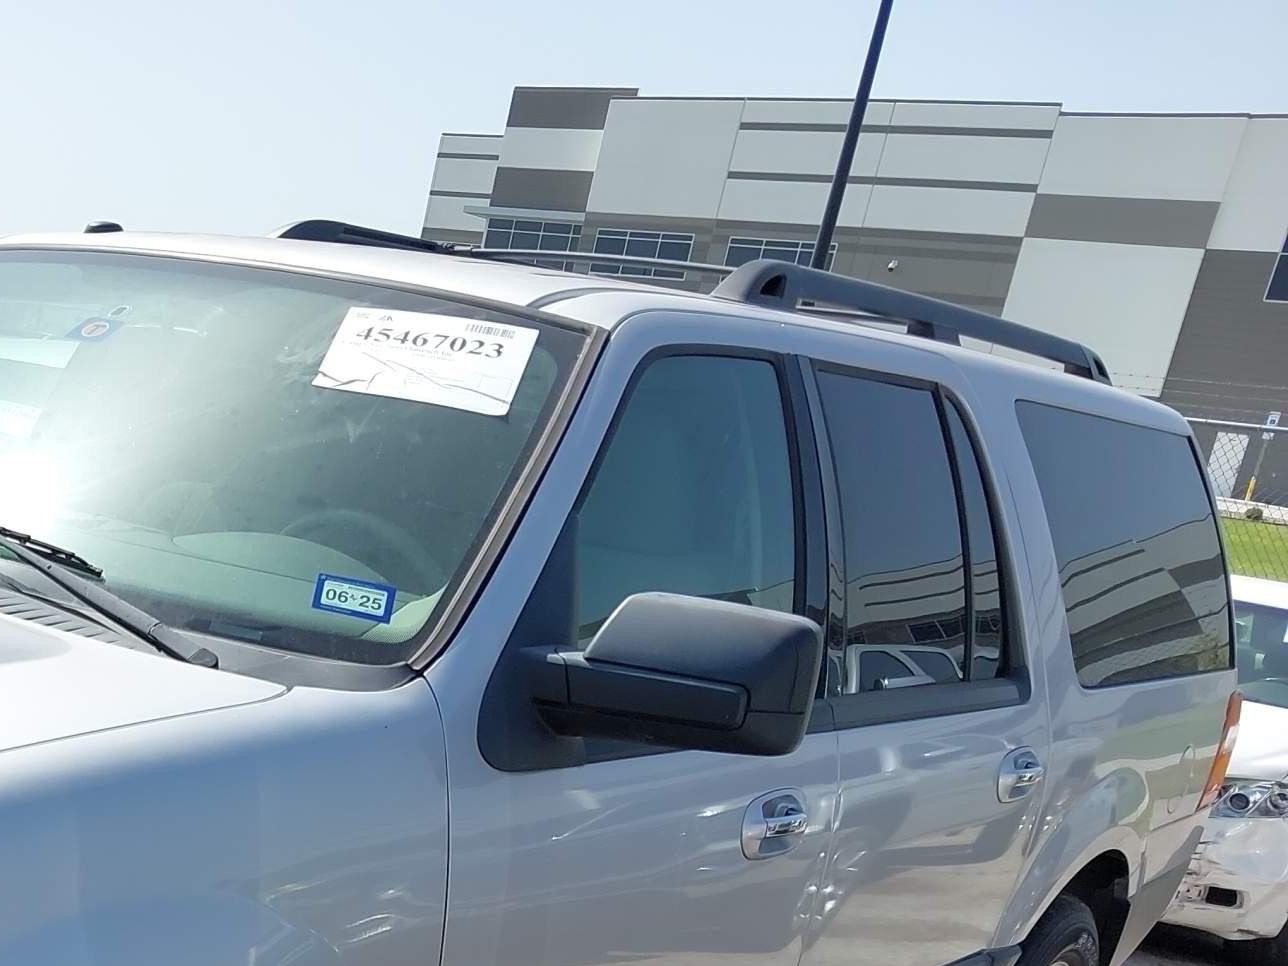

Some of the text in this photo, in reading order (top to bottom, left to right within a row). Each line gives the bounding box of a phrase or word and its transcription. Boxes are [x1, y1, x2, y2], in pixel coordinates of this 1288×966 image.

[355, 325, 505, 359] 45467023
[325, 588, 349, 604] 06
[358, 595, 383, 611] 25
